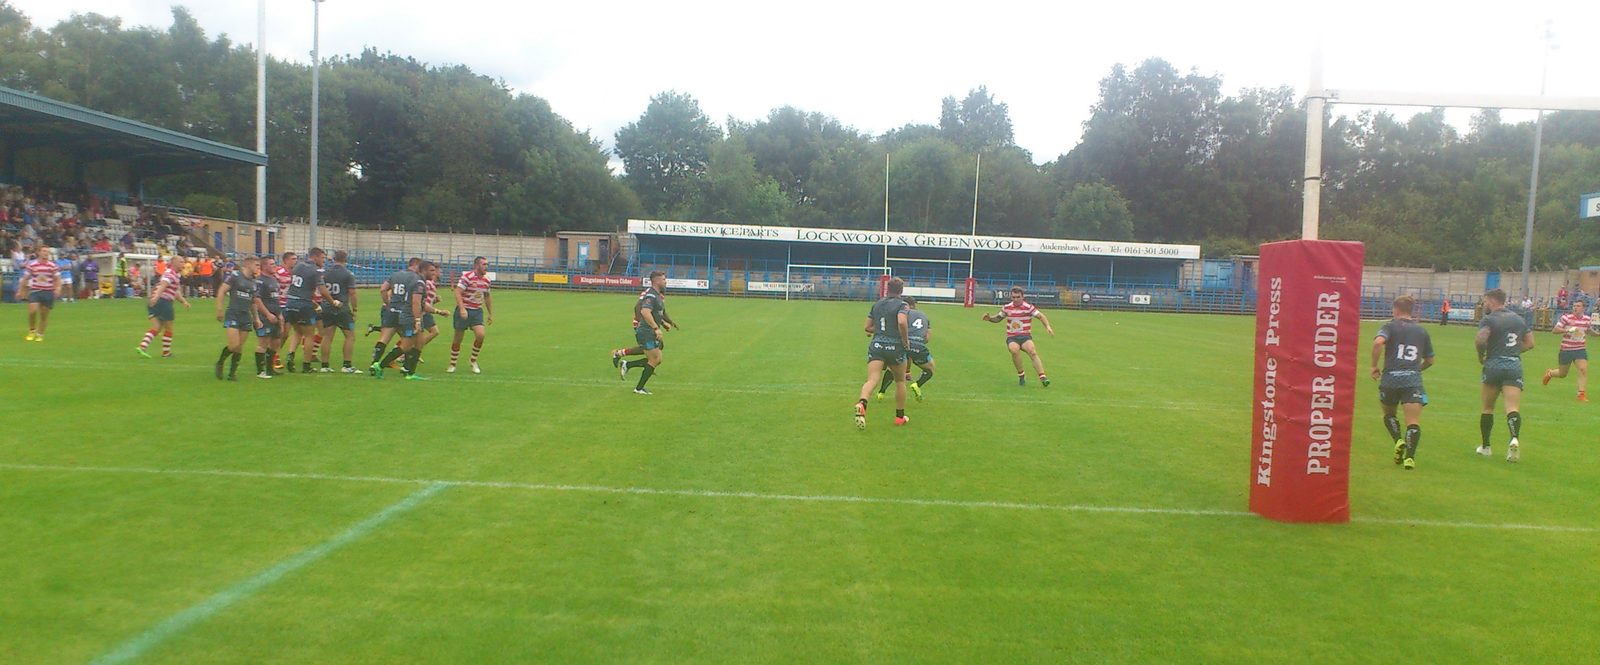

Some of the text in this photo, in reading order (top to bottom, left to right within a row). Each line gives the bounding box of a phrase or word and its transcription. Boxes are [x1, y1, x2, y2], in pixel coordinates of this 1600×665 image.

[648, 223, 687, 233] SALES
[796, 229, 1023, 250] LOCKWOOD & GREENWOOD
[1040, 242, 1079, 252] Audenshaw
[325, 282, 341, 295] 20
[393, 283, 406, 295] 16
[879, 317, 886, 331] 1
[912, 318, 924, 329] 4
[1314, 291, 1340, 368] CIDER
[1505, 332, 1518, 347] 3
[1397, 344, 1418, 362] 13
[1256, 276, 1282, 488] Kingstone Press
[1307, 374, 1336, 475] PROPER
